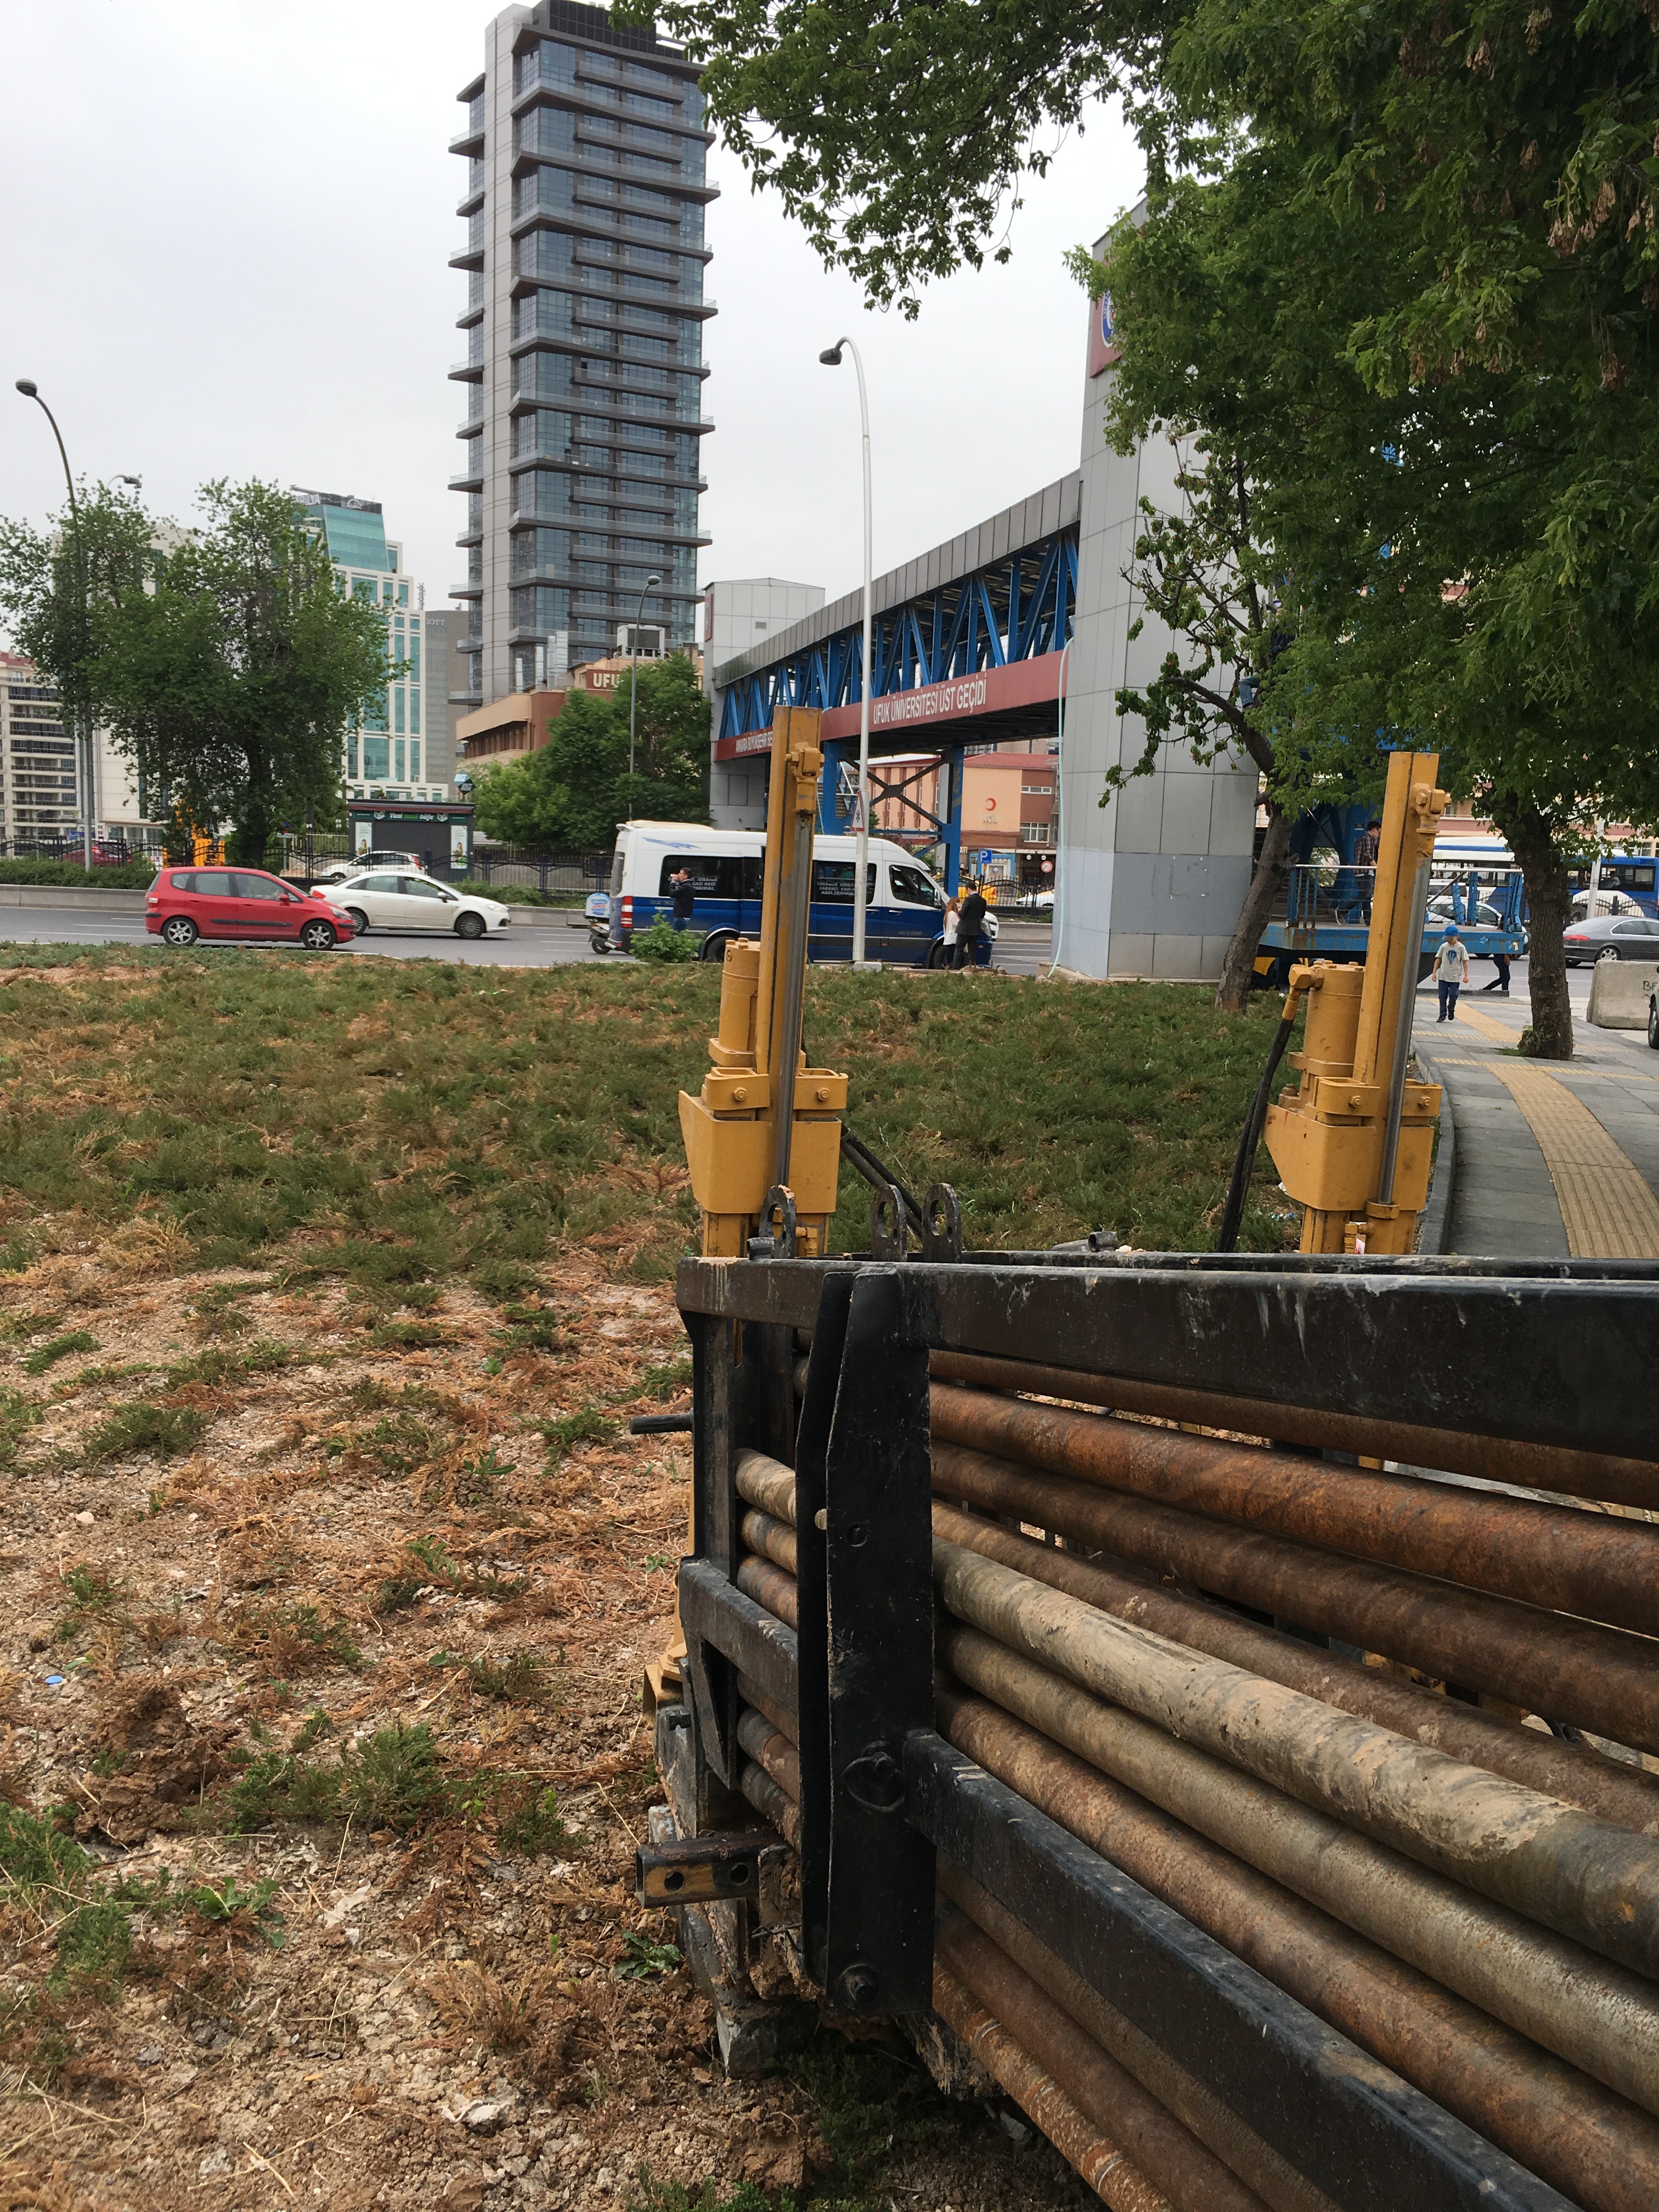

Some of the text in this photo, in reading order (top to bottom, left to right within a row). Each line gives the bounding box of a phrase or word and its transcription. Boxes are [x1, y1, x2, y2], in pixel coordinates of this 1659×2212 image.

[873, 673, 986, 724] UFUK ÜNİVERSİTESİ ÜST GEÇİDİ
[980, 851, 988, 862] P
